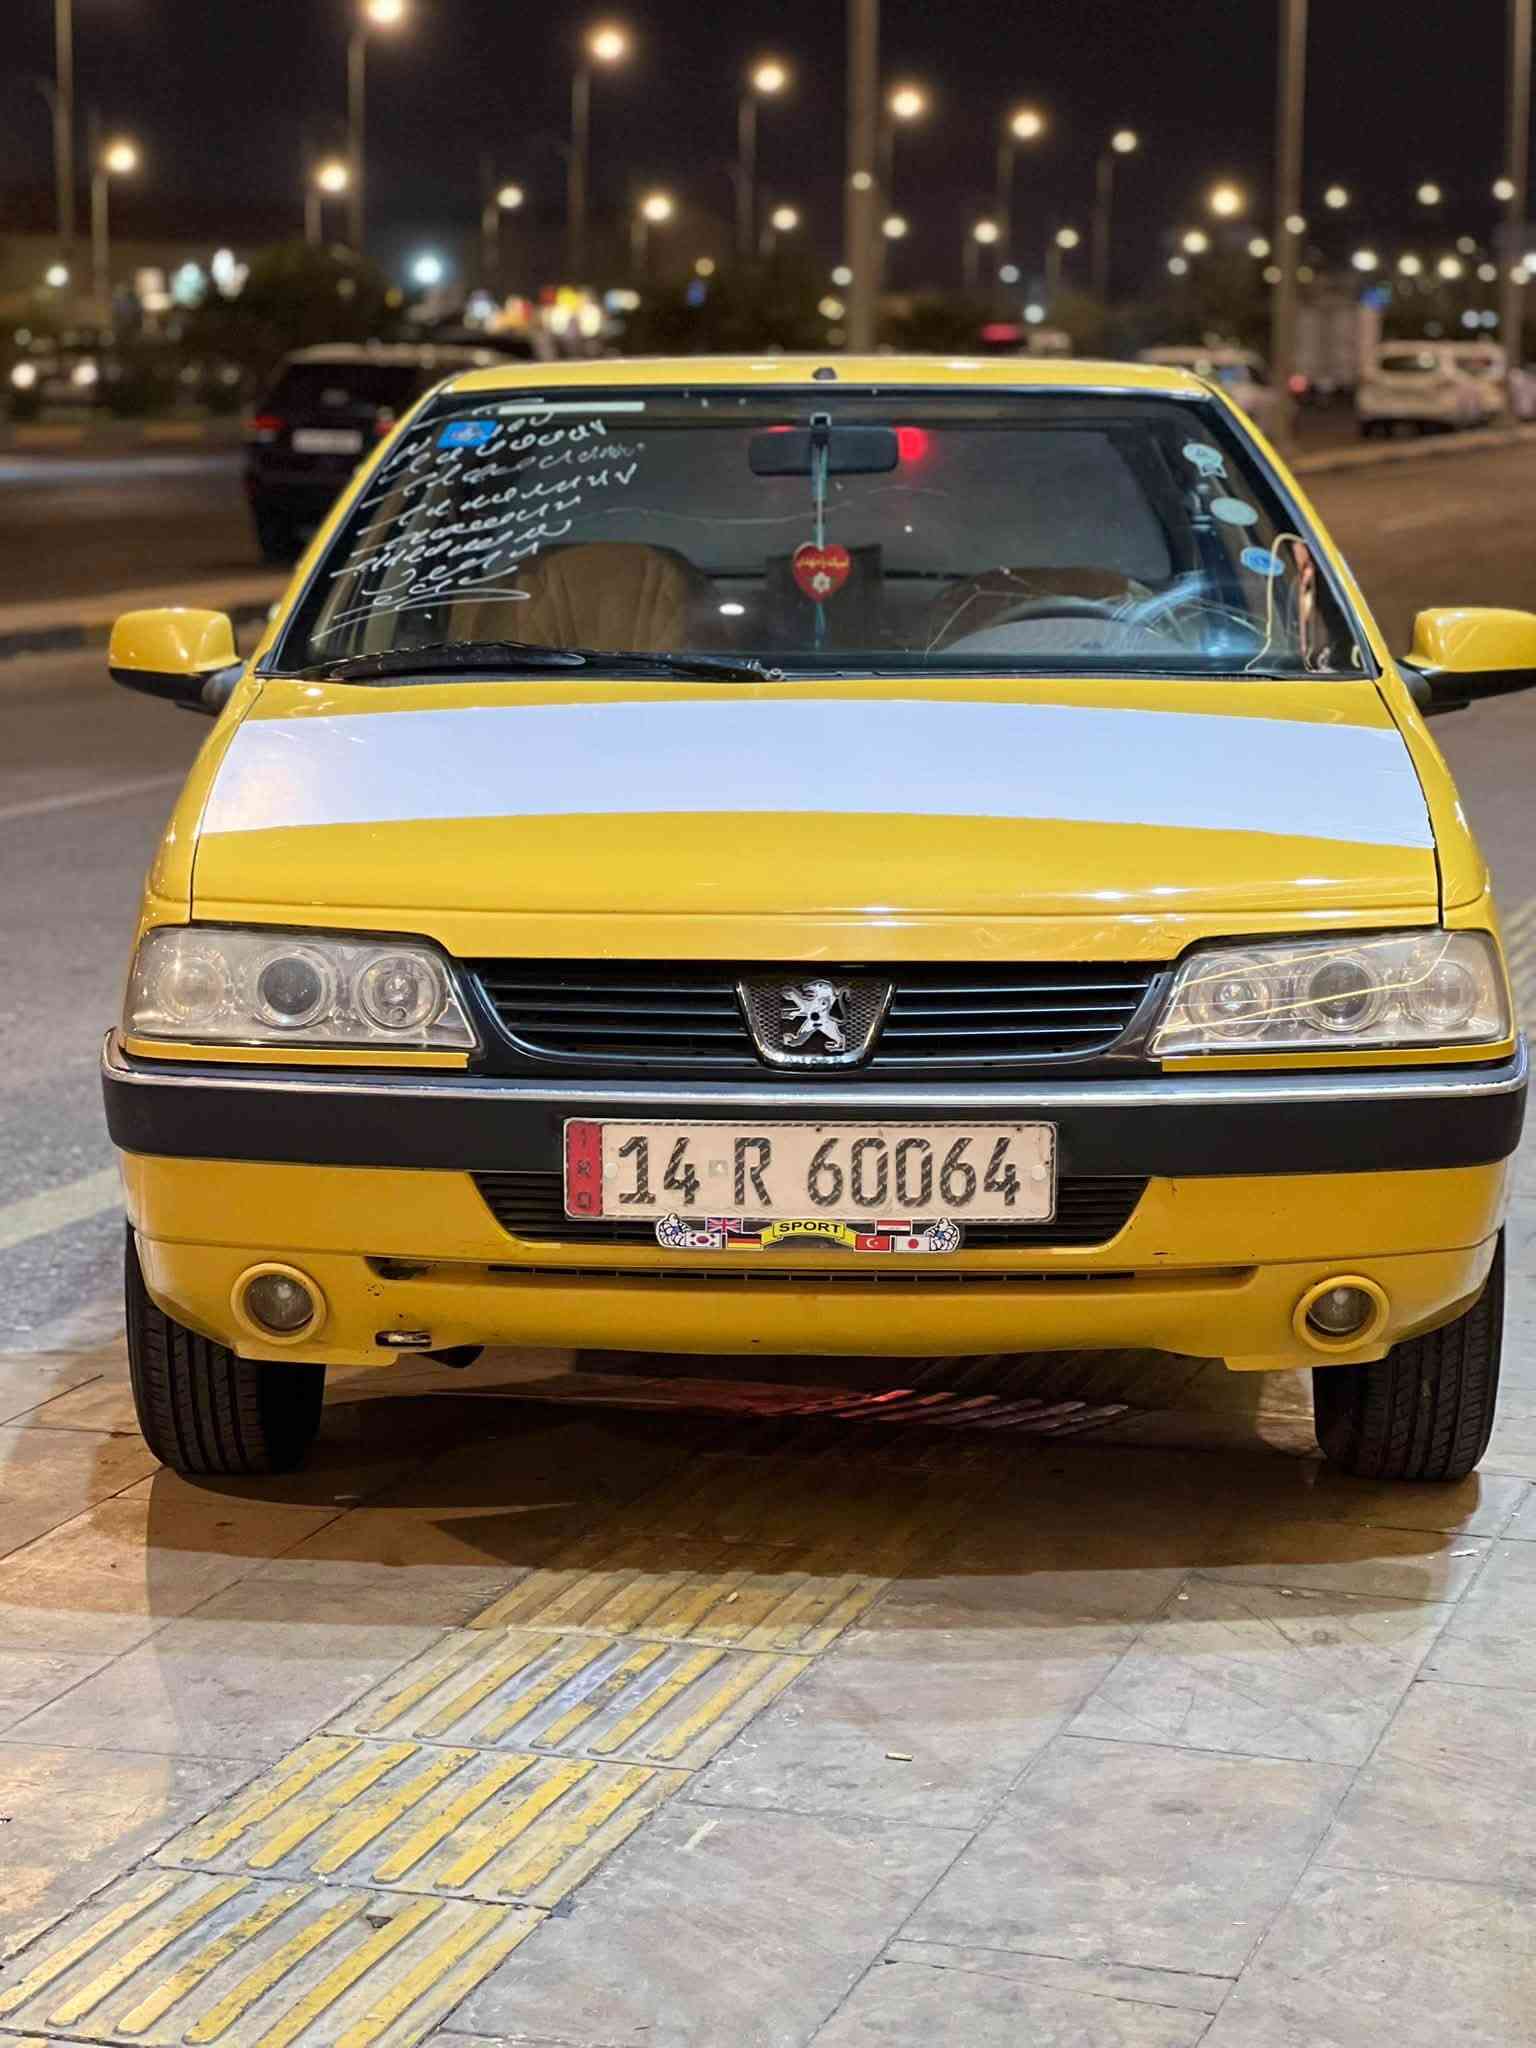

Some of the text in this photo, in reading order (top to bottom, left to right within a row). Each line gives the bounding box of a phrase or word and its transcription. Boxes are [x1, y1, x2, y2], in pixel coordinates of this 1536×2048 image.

[618, 1136, 1022, 1207] 14 R 60064
[778, 1221, 842, 1234] SPORT
